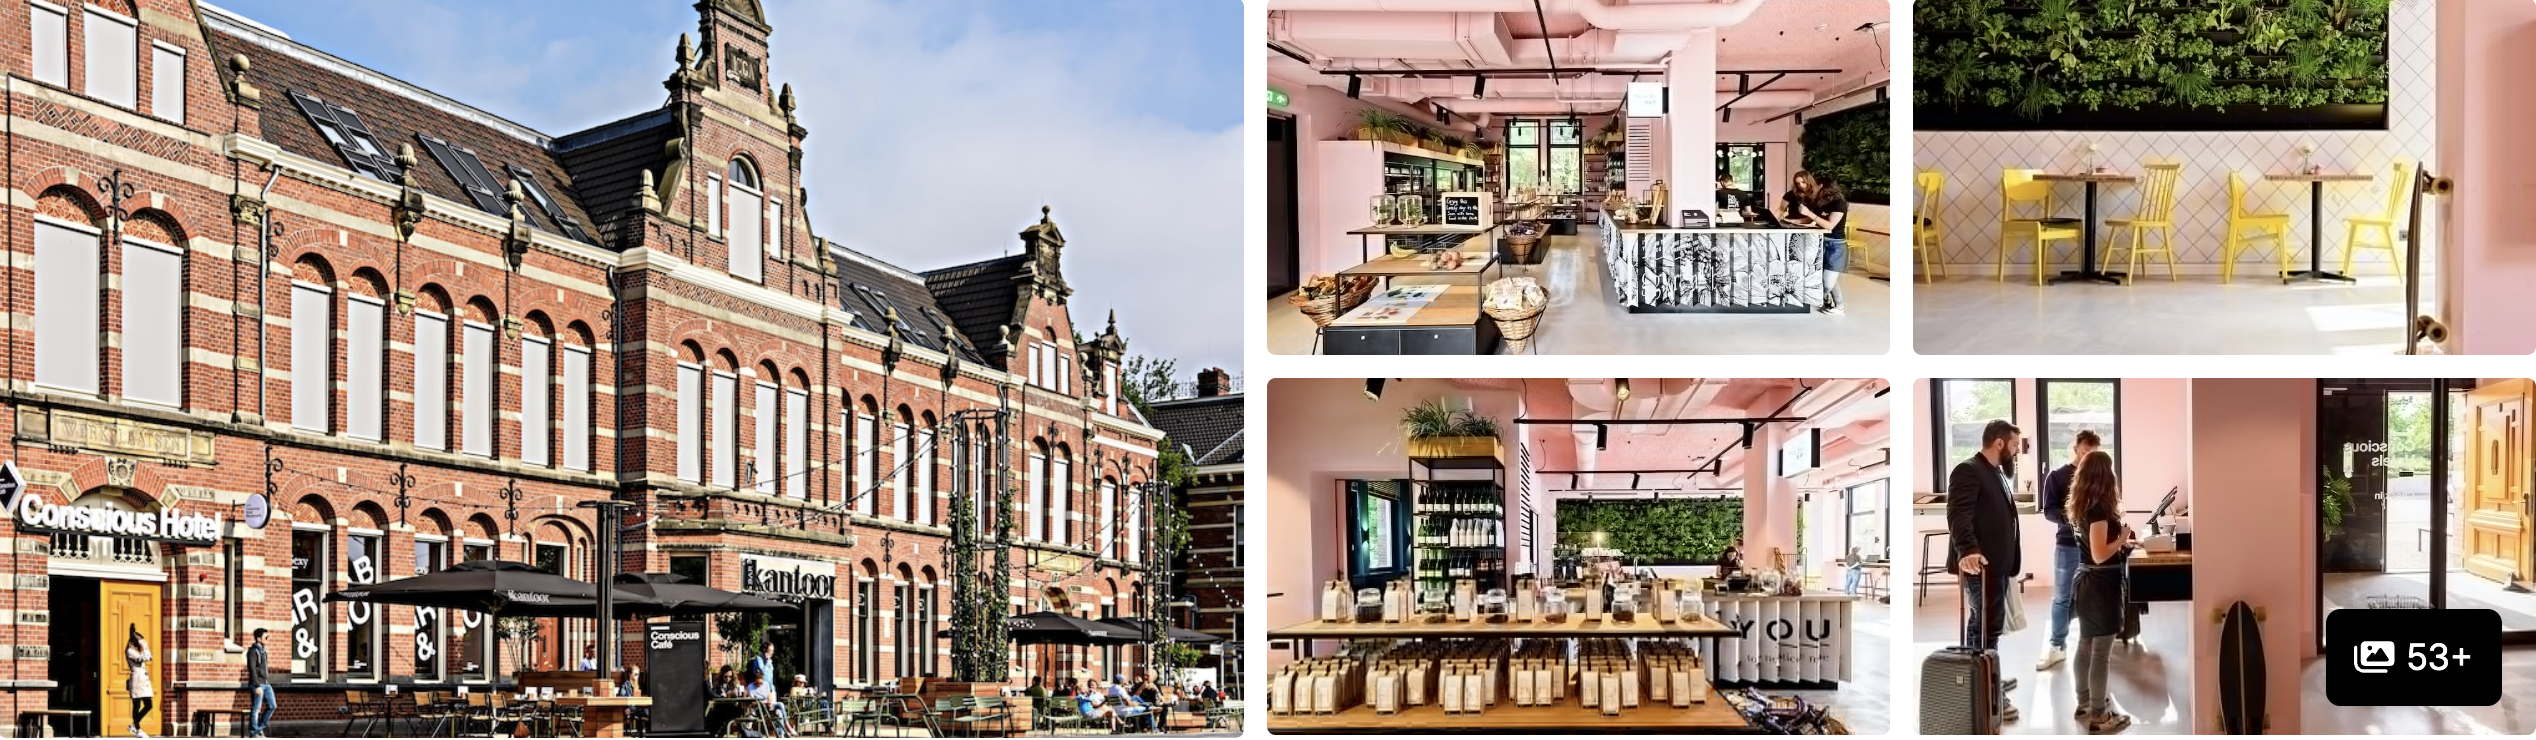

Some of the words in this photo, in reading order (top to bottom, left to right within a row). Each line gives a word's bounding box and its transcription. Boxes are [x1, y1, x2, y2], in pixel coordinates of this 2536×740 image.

[20, 493, 157, 535] Conscious
[160, 507, 222, 540] Hotel
[295, 627, 318, 658] &
[650, 631, 700, 641] Conscious
[1730, 619, 1830, 641] YOU
[416, 632, 437, 661] &
[650, 640, 673, 650] Café
